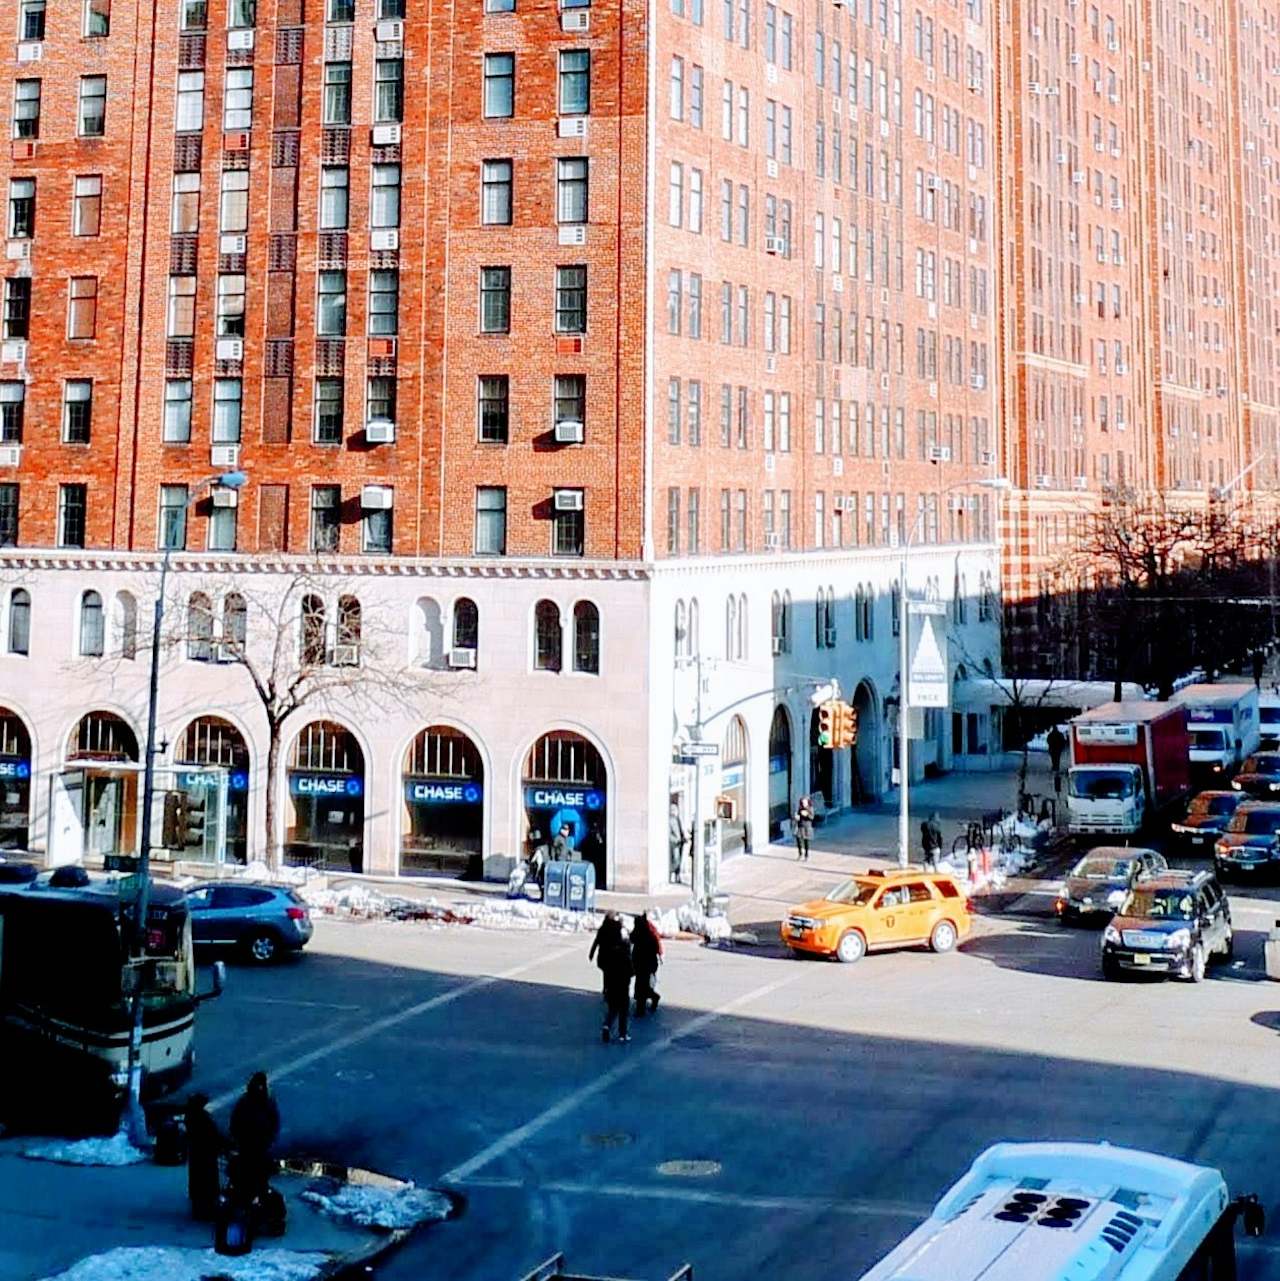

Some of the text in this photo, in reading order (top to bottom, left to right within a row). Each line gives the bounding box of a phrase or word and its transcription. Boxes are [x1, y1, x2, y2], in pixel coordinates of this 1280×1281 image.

[185, 771, 231, 786] CHAE
[297, 778, 345, 793] CHASE
[414, 785, 463, 800] CHASE
[534, 790, 585, 806] CHASE
